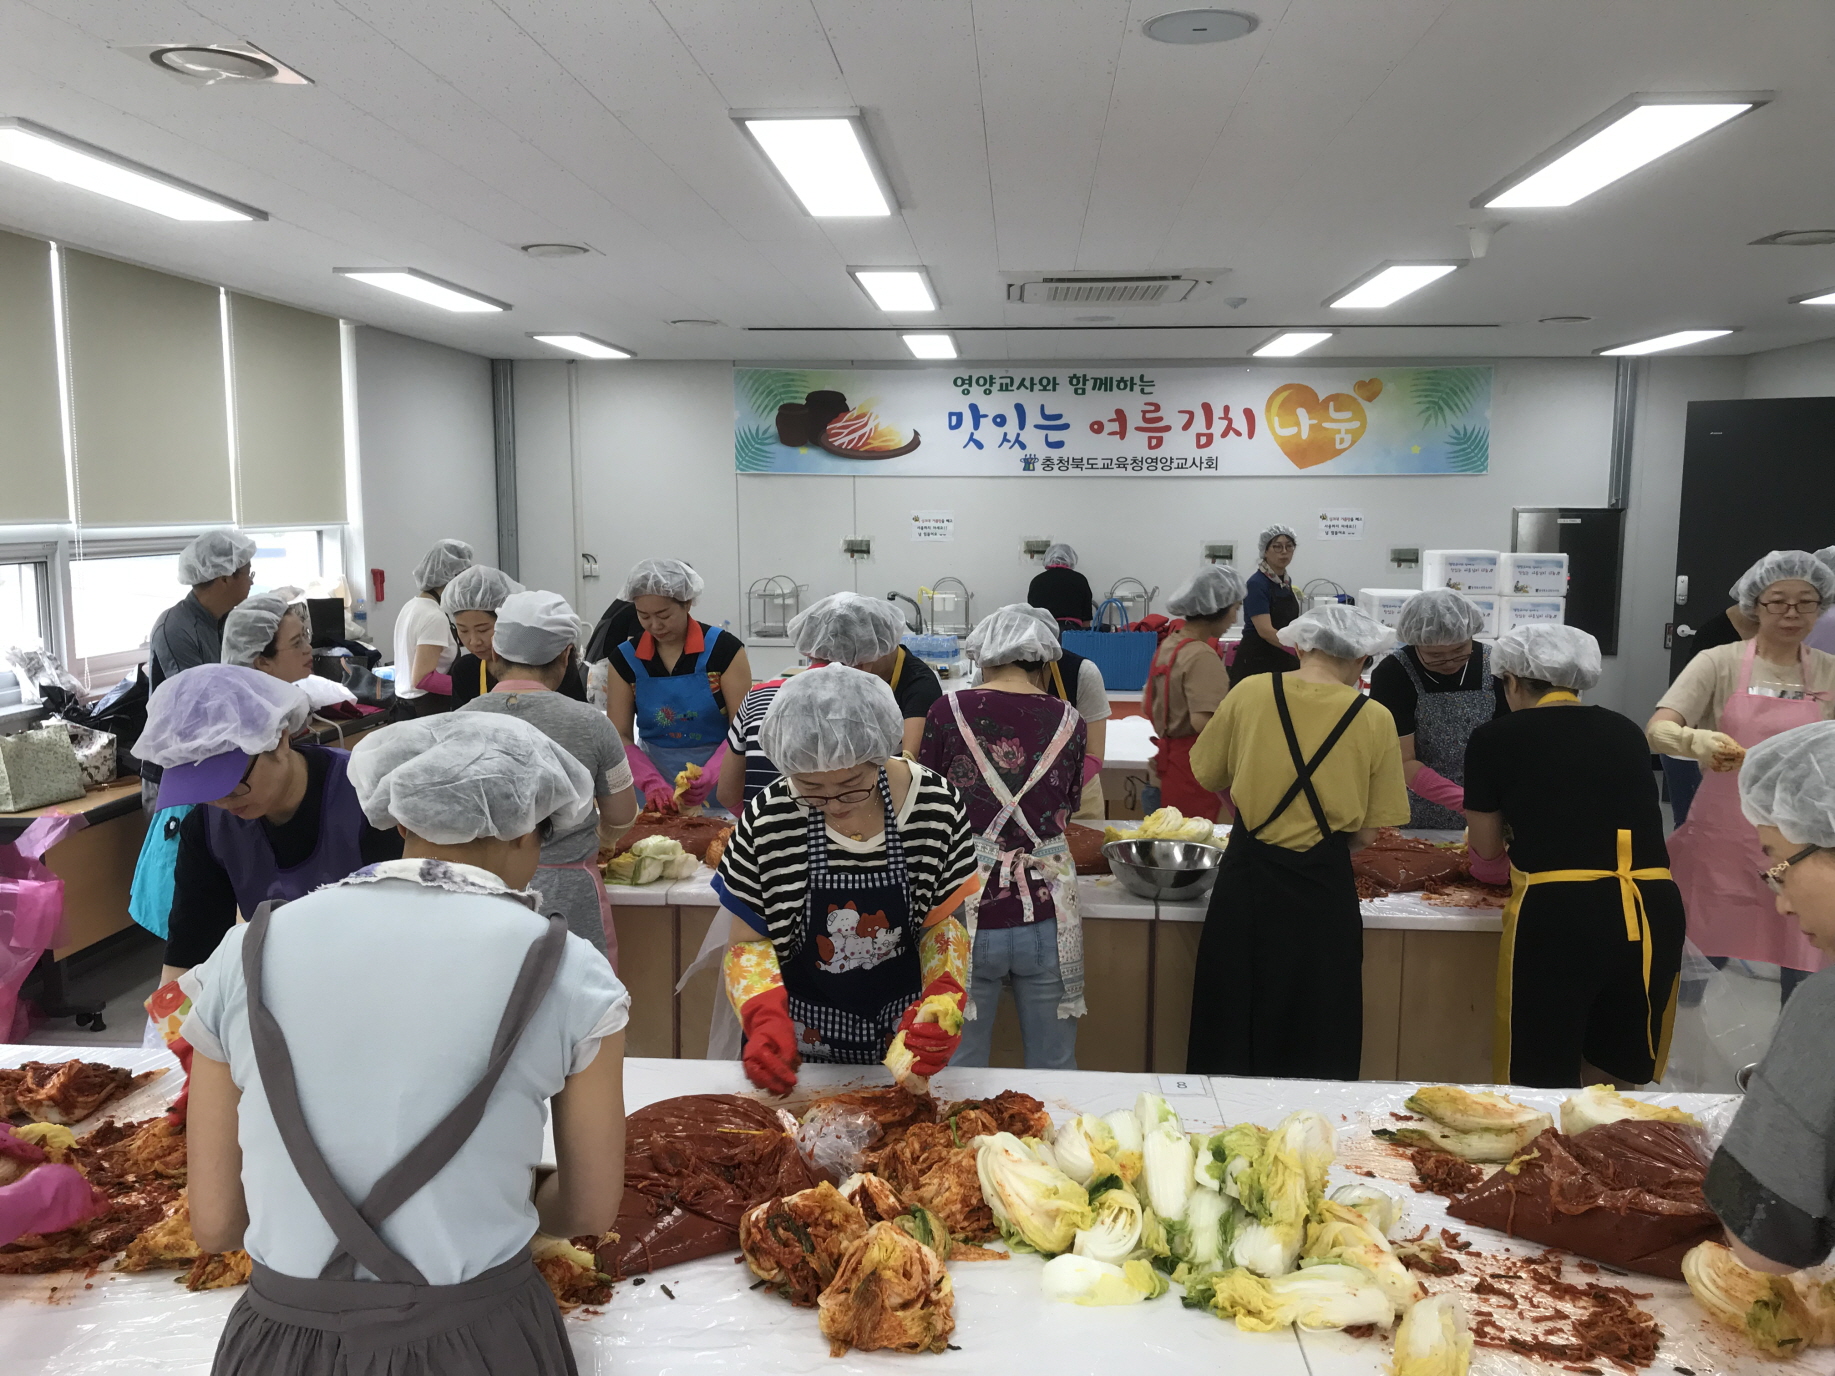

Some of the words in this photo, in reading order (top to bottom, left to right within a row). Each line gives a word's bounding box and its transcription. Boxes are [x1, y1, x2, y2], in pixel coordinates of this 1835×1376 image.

[952, 375, 1061, 396] 영양교사와
[1067, 374, 1157, 396] 함께하는
[947, 402, 1071, 451] 맛있는
[1274, 401, 1361, 450] 나눔
[1040, 456, 1219, 472] 충청북도교육청영양교사회
[1176, 1081, 1188, 1089] 8
